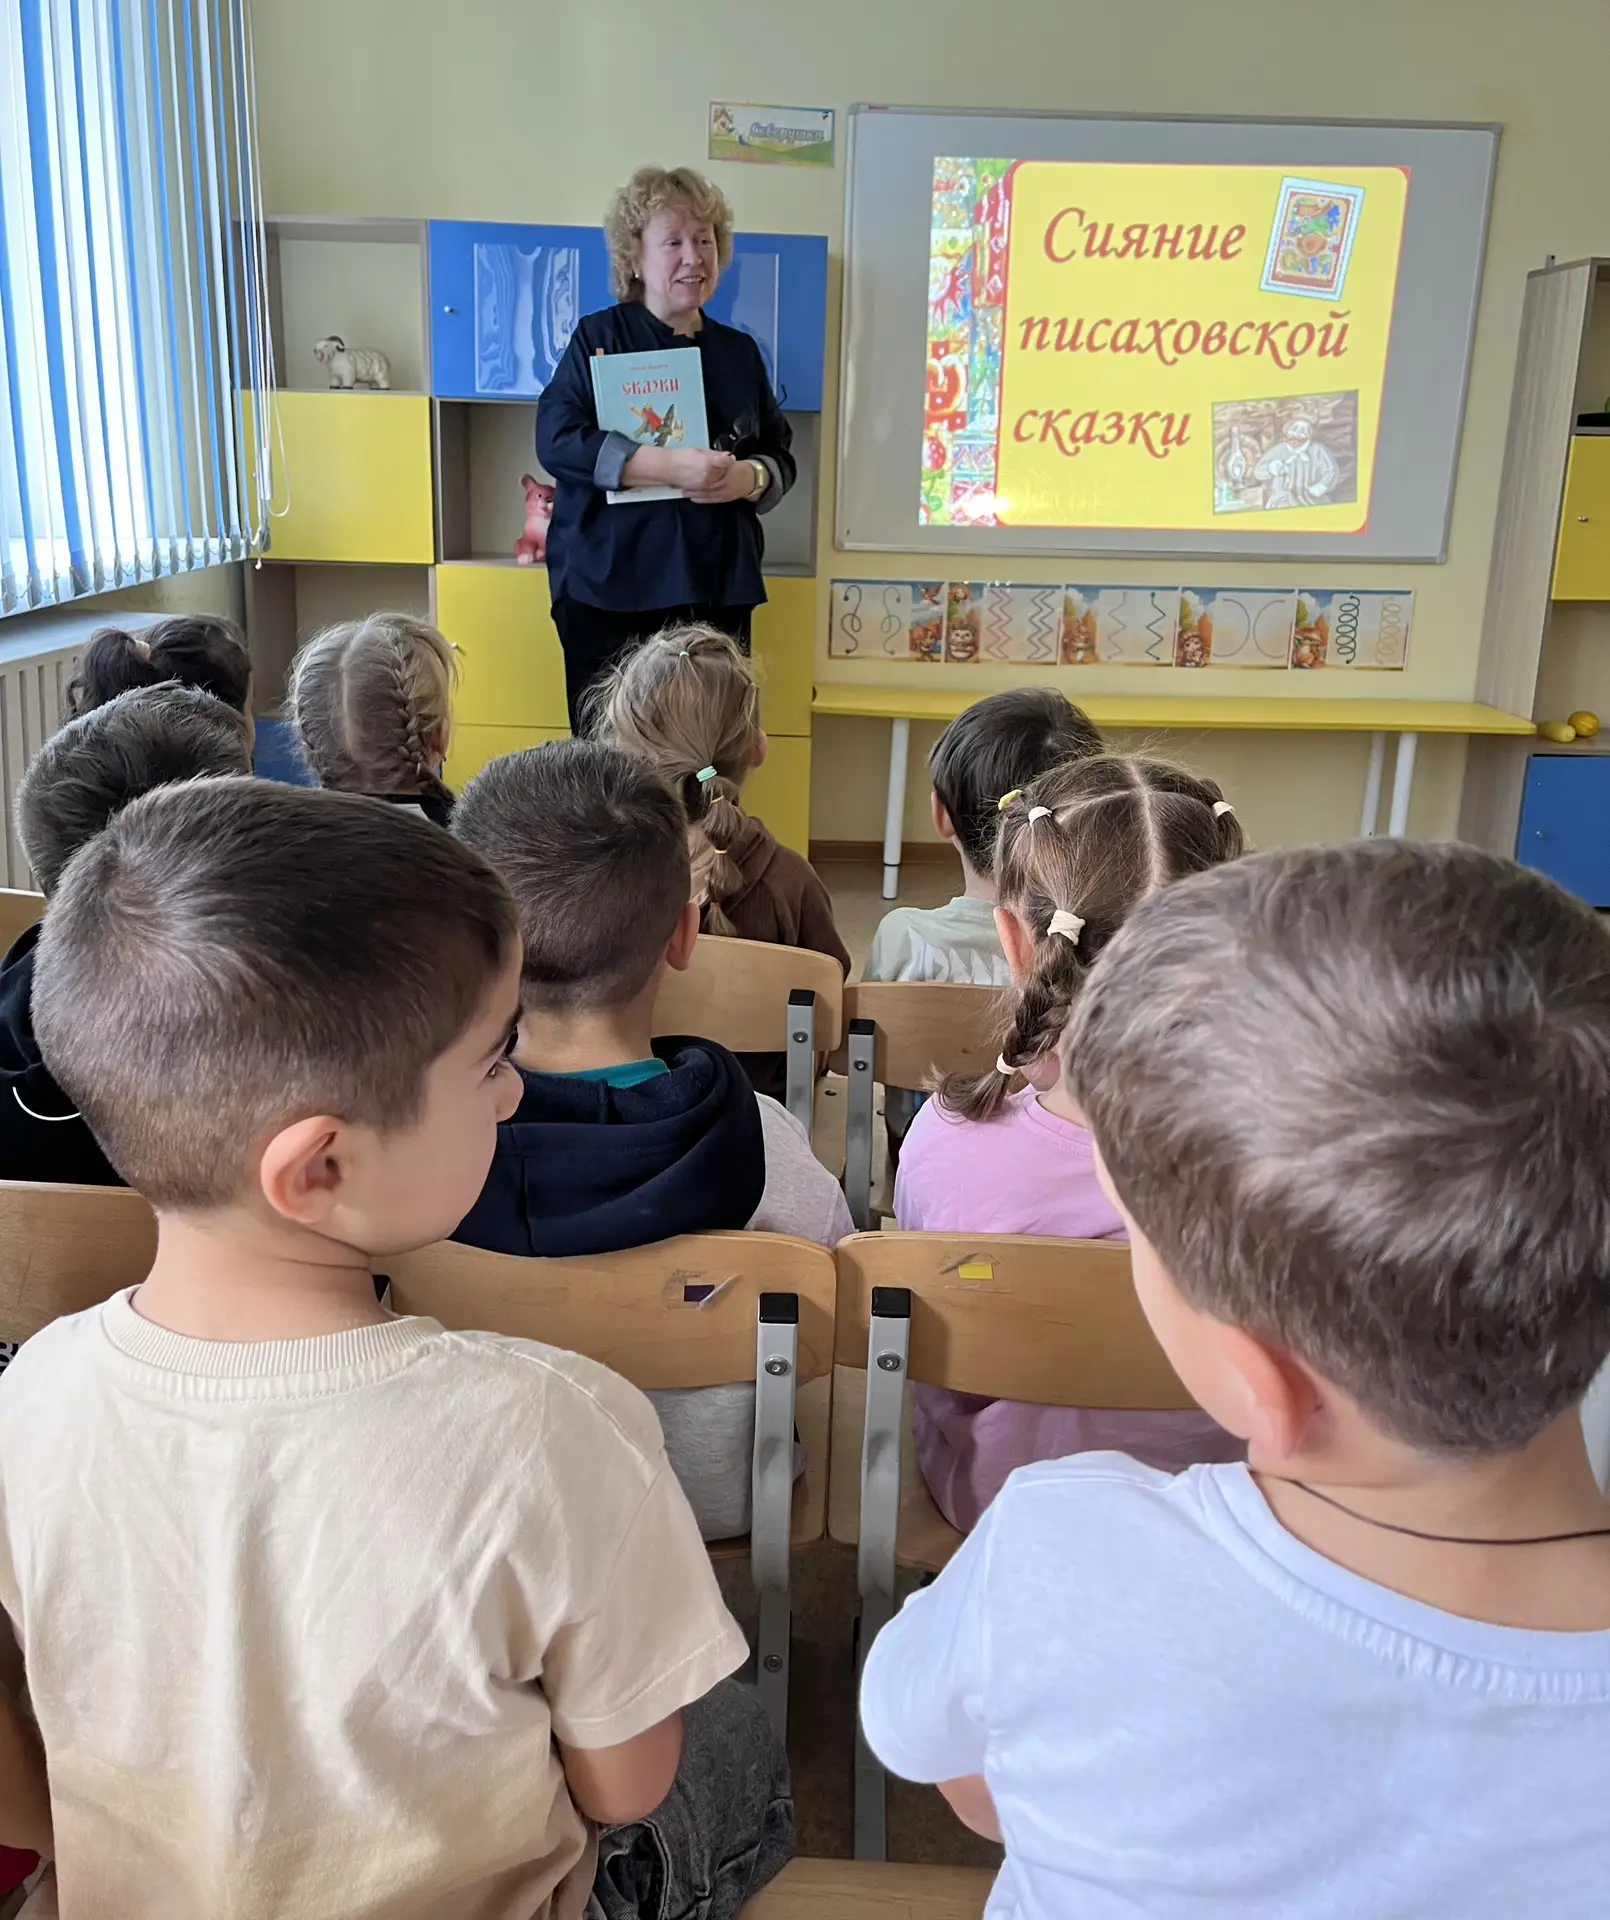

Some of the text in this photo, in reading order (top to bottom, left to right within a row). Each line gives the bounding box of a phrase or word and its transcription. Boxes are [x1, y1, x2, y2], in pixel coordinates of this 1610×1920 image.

[1043, 206, 1247, 264] Сияние
[1019, 309, 1351, 370] писаховской
[622, 377, 680, 395] СКАЗКИ
[1013, 408, 1192, 459] сказки
